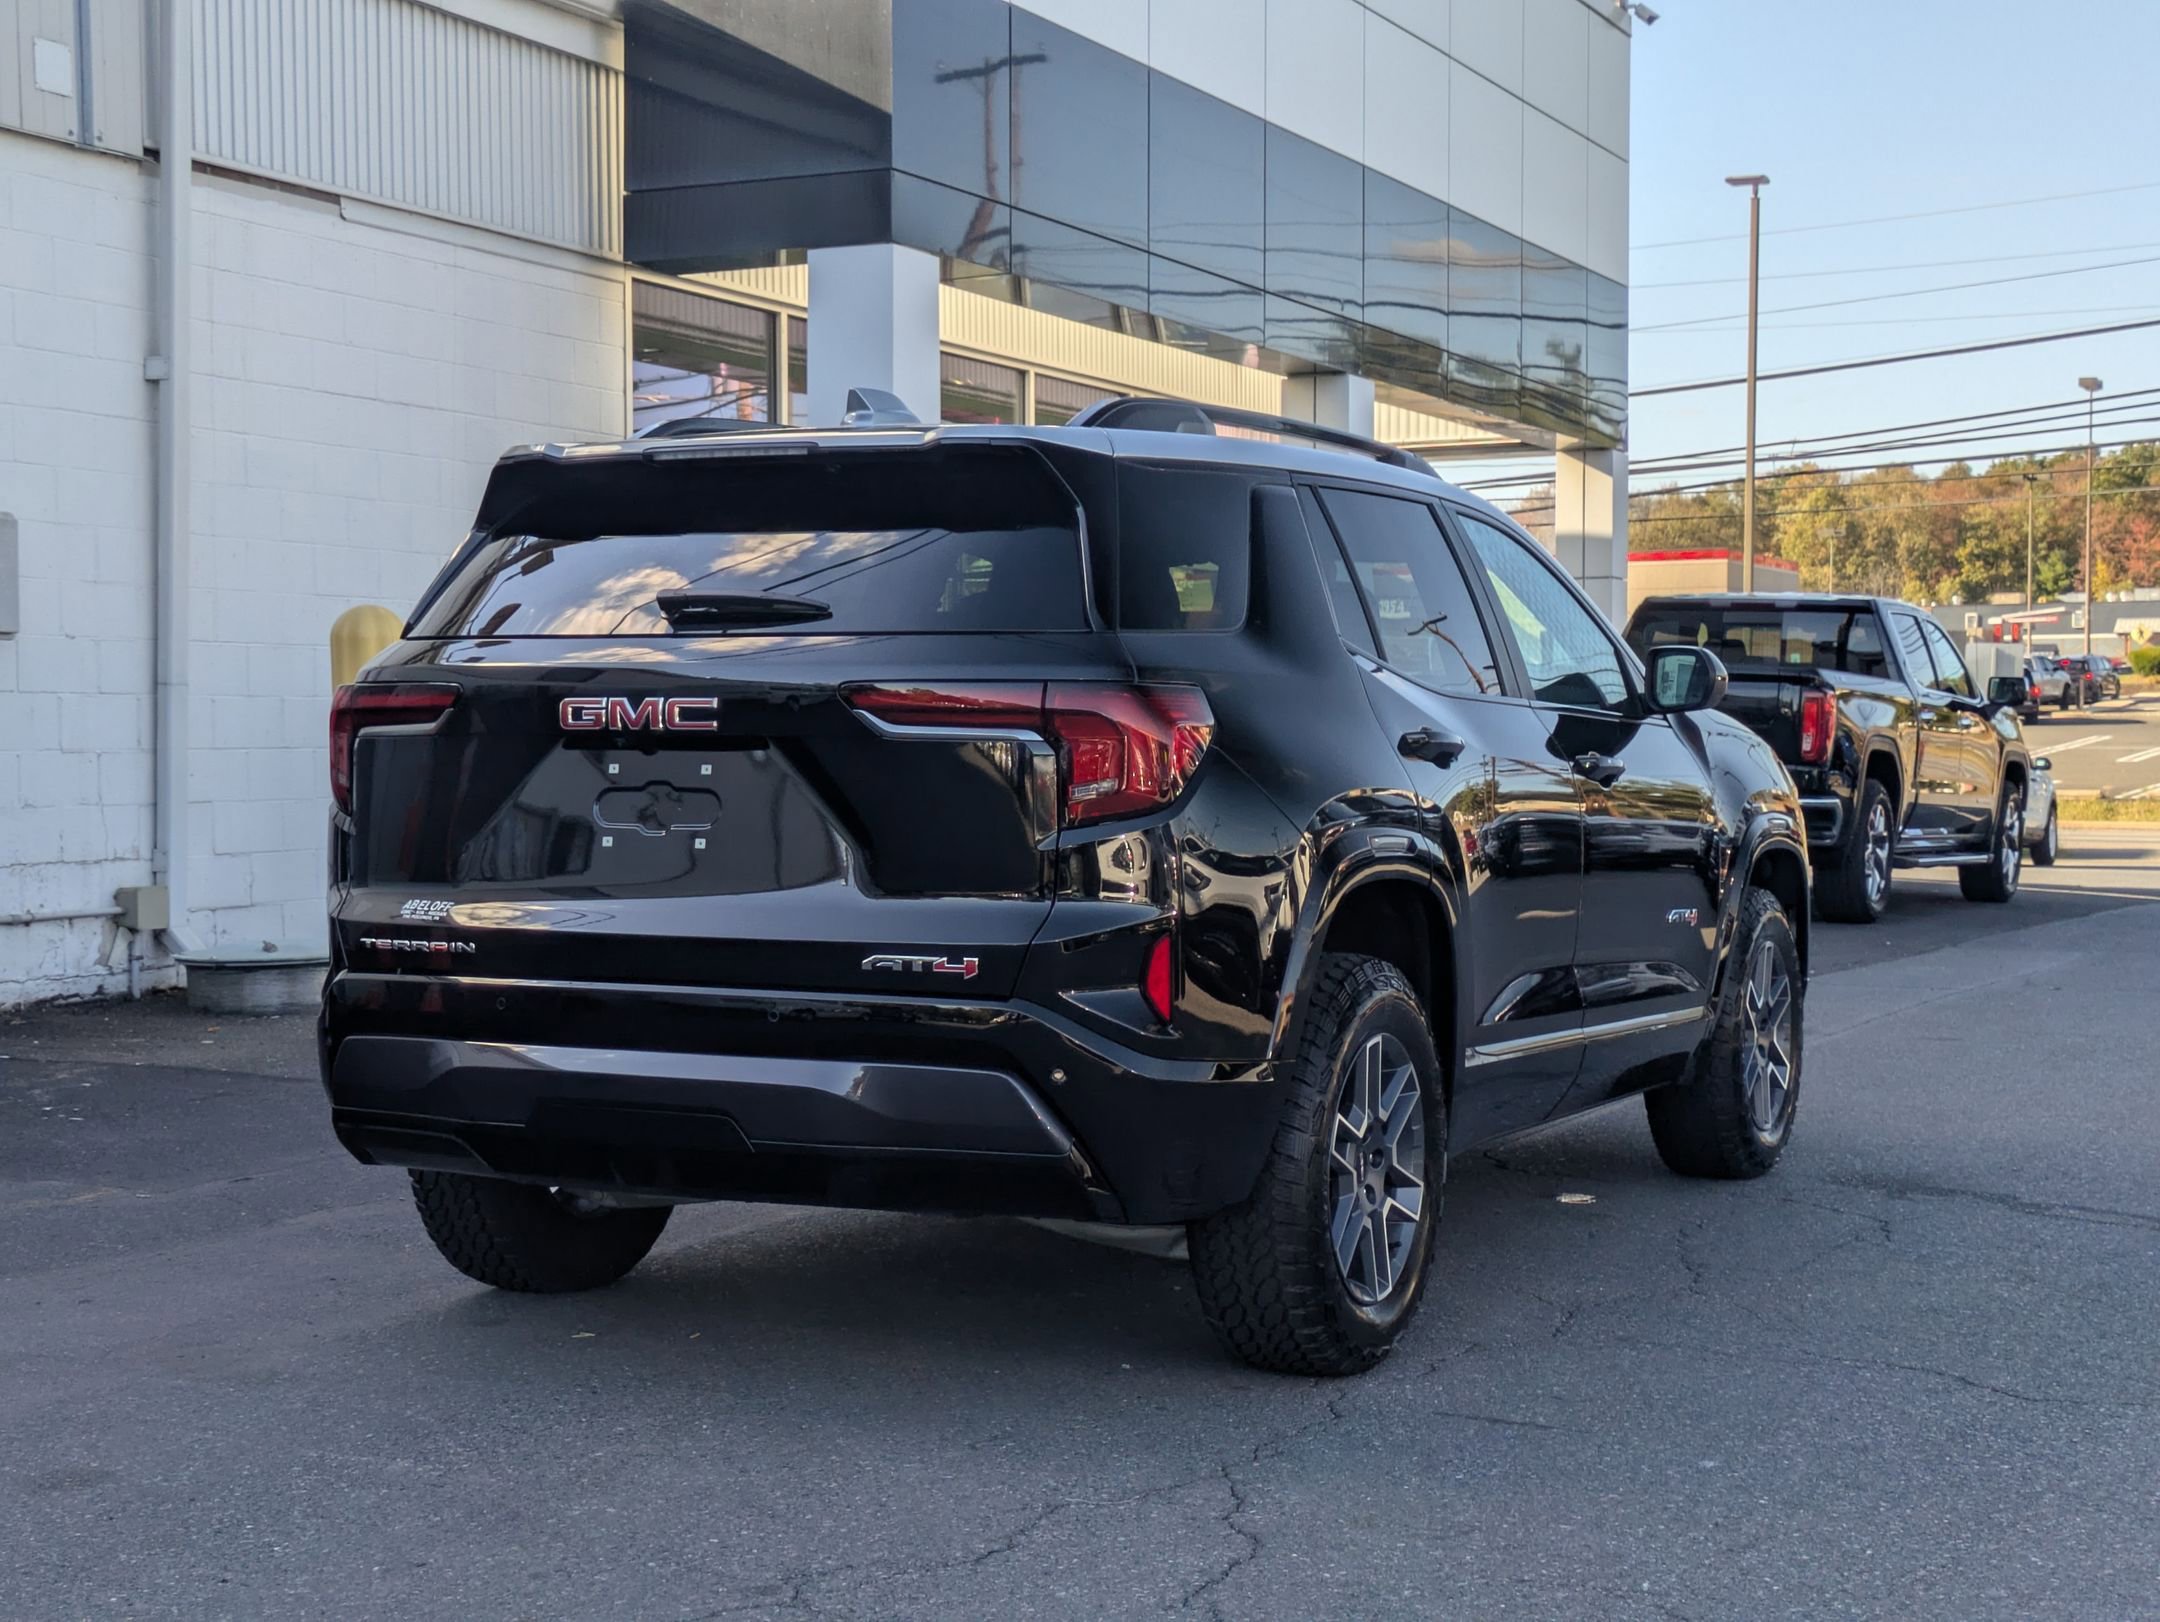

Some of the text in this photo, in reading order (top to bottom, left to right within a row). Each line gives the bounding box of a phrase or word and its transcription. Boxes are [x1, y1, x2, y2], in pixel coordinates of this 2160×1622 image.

[559, 697, 718, 731] GMC
[402, 899, 455, 911] ABELOFF
[1666, 908, 1698, 927] AT4
[359, 938, 476, 953] TERRAIN
[861, 954, 979, 980] AT4
